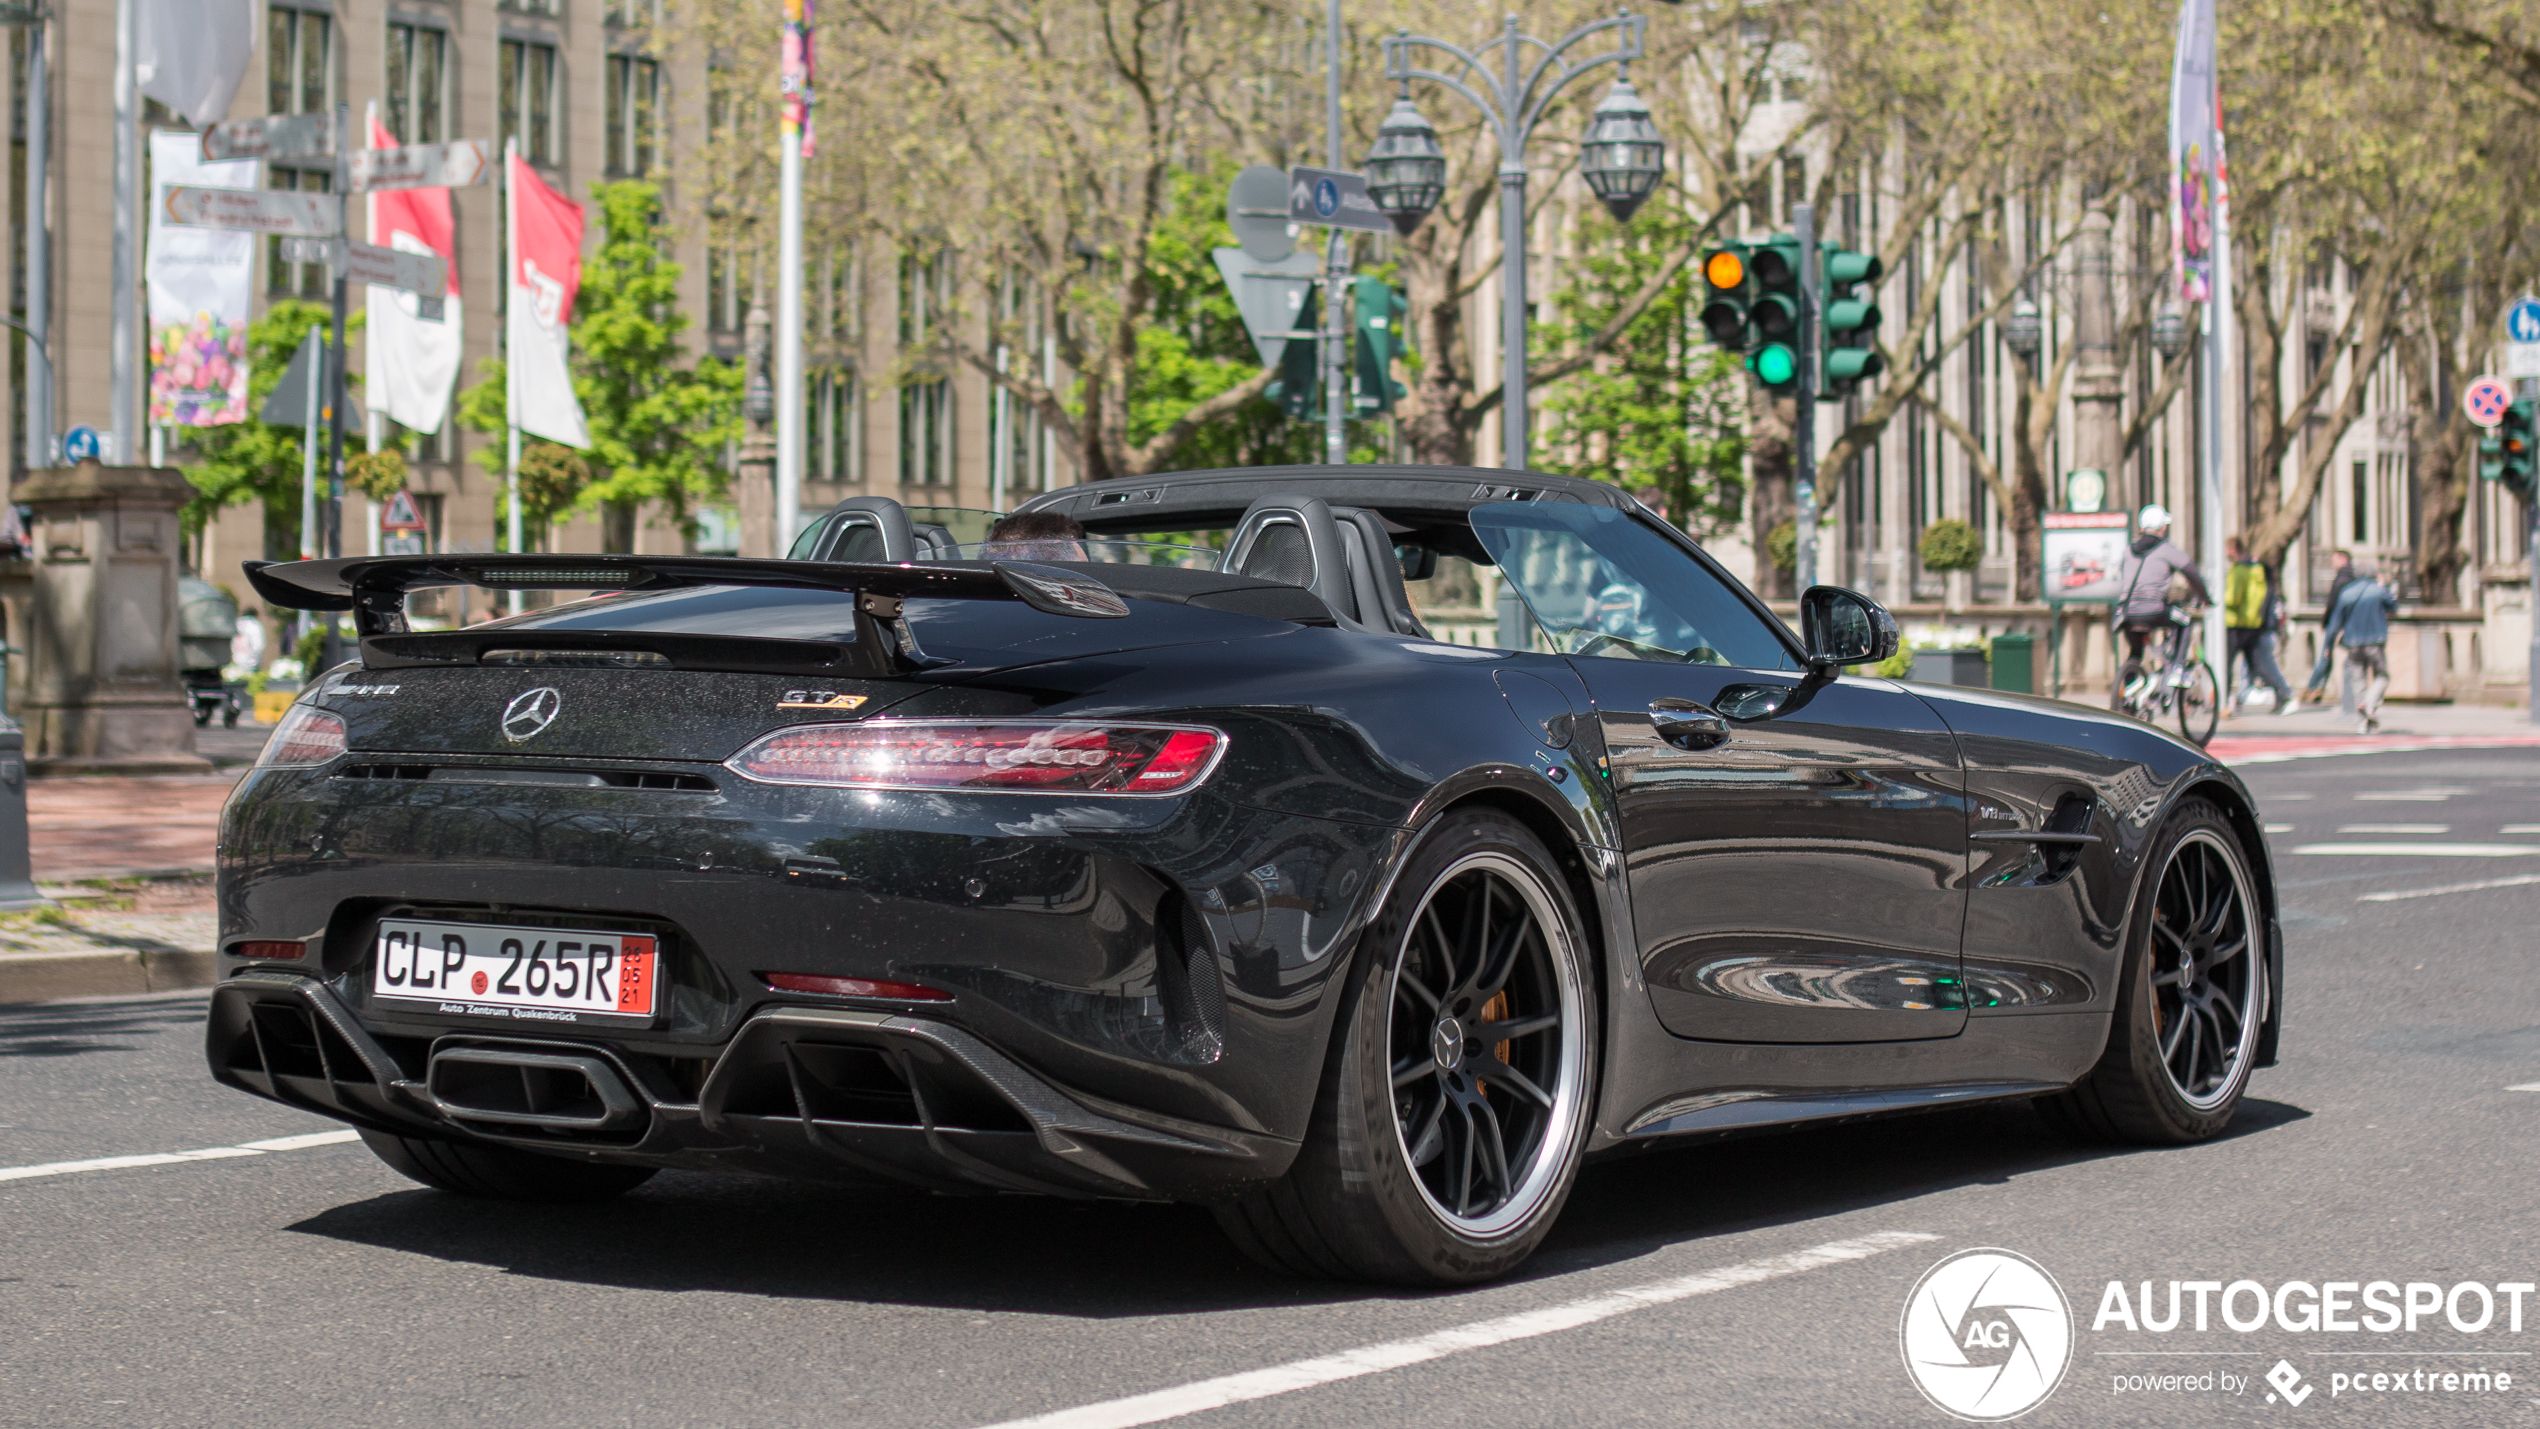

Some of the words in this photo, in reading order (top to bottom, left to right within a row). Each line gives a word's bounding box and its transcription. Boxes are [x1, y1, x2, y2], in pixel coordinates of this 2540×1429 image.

[1980, 806, 1998, 820] V8
[383, 931, 466, 989] CLP
[497, 938, 614, 1001] 265R
[621, 987, 639, 1004] 21
[439, 1003, 464, 1013] Auto
[466, 1005, 509, 1016] Zentrum
[512, 1008, 577, 1021] Quakenbrück
